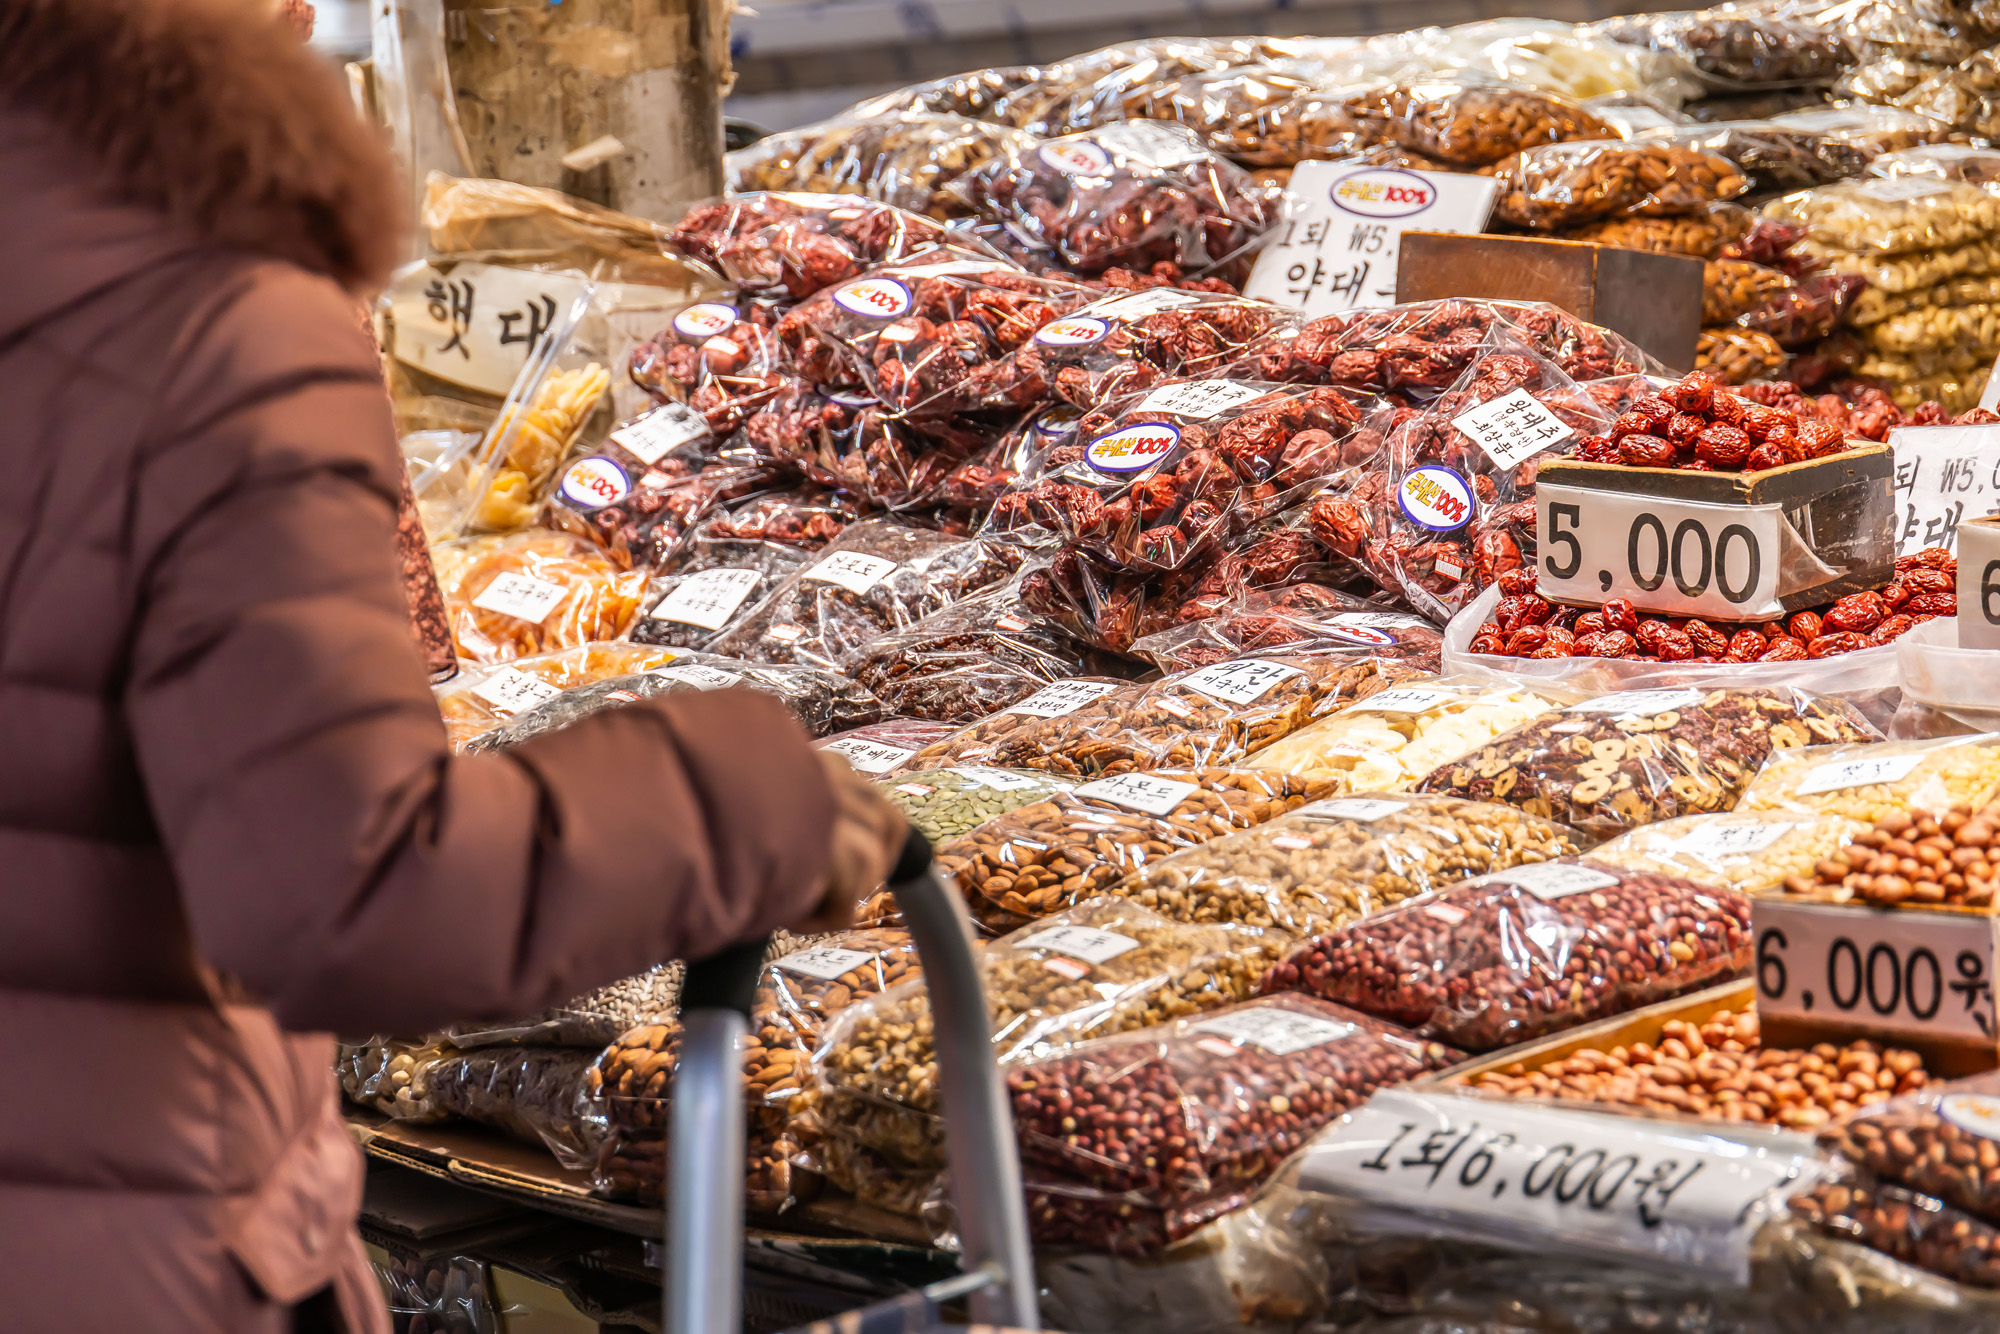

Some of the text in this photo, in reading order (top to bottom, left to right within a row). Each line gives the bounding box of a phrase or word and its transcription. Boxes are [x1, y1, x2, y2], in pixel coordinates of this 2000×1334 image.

[1287, 257, 1396, 305] 약대
[1505, 400, 1561, 442] 왕대추
[1545, 501, 1761, 604] 5,000
[1043, 683, 1105, 697] 미캐슈
[1214, 662, 1286, 686] 피칸
[1105, 777, 1174, 799] 아몬드
